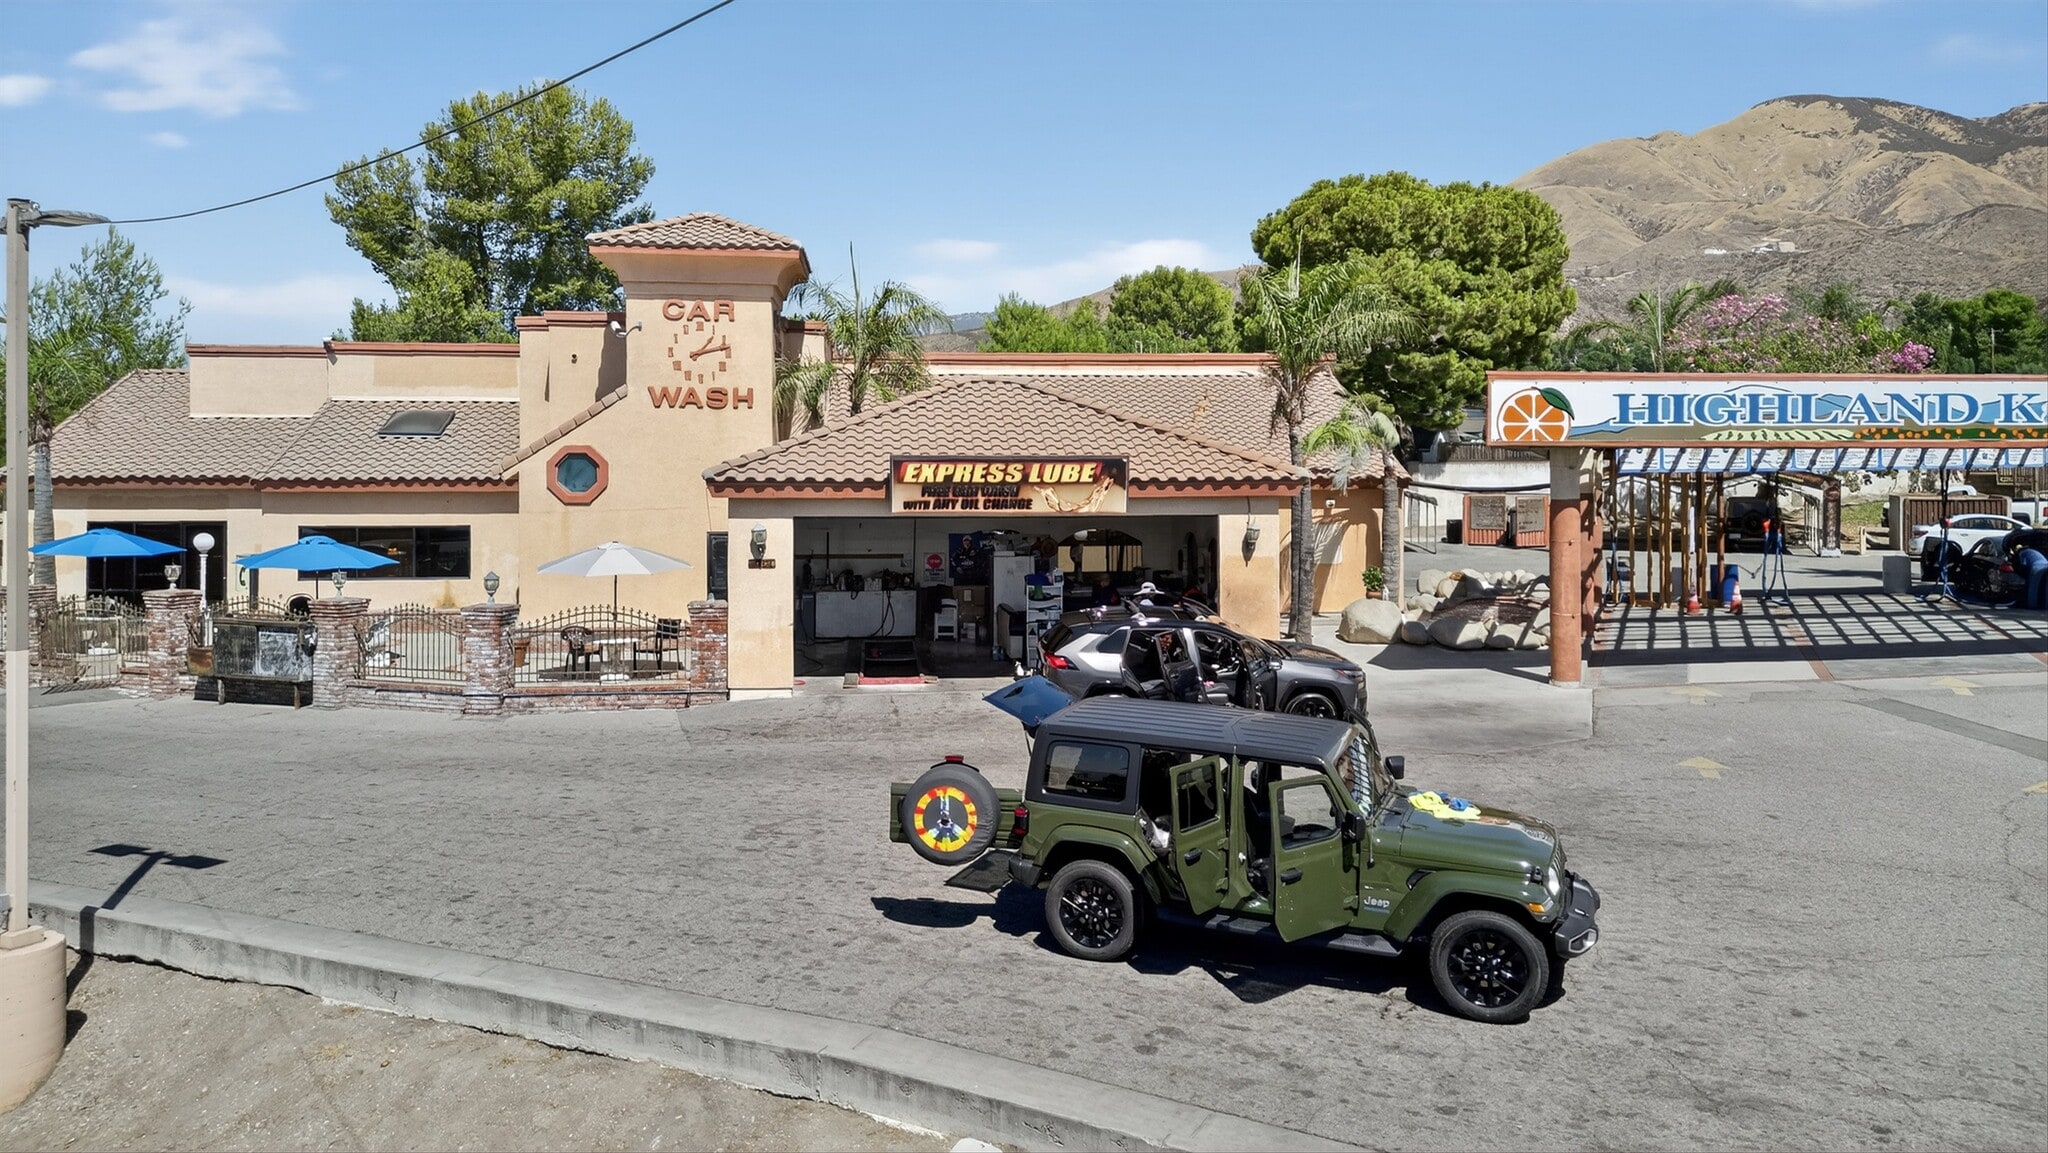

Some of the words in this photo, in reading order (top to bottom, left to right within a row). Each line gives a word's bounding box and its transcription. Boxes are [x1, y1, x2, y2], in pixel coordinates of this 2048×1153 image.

[662, 299, 735, 322] CAR
[647, 386, 754, 410] WASH
[1613, 392, 1982, 426] HIGHLAND
[1997, 392, 2048, 426] K
[903, 463, 1023, 484] EXPRESS
[1028, 463, 1096, 484] LUBE
[903, 501, 931, 511] WITH
[932, 499, 959, 511] ANY
[960, 499, 980, 510] OIL
[982, 499, 1033, 511] CHANGE
[1363, 896, 1390, 908] Jeep
